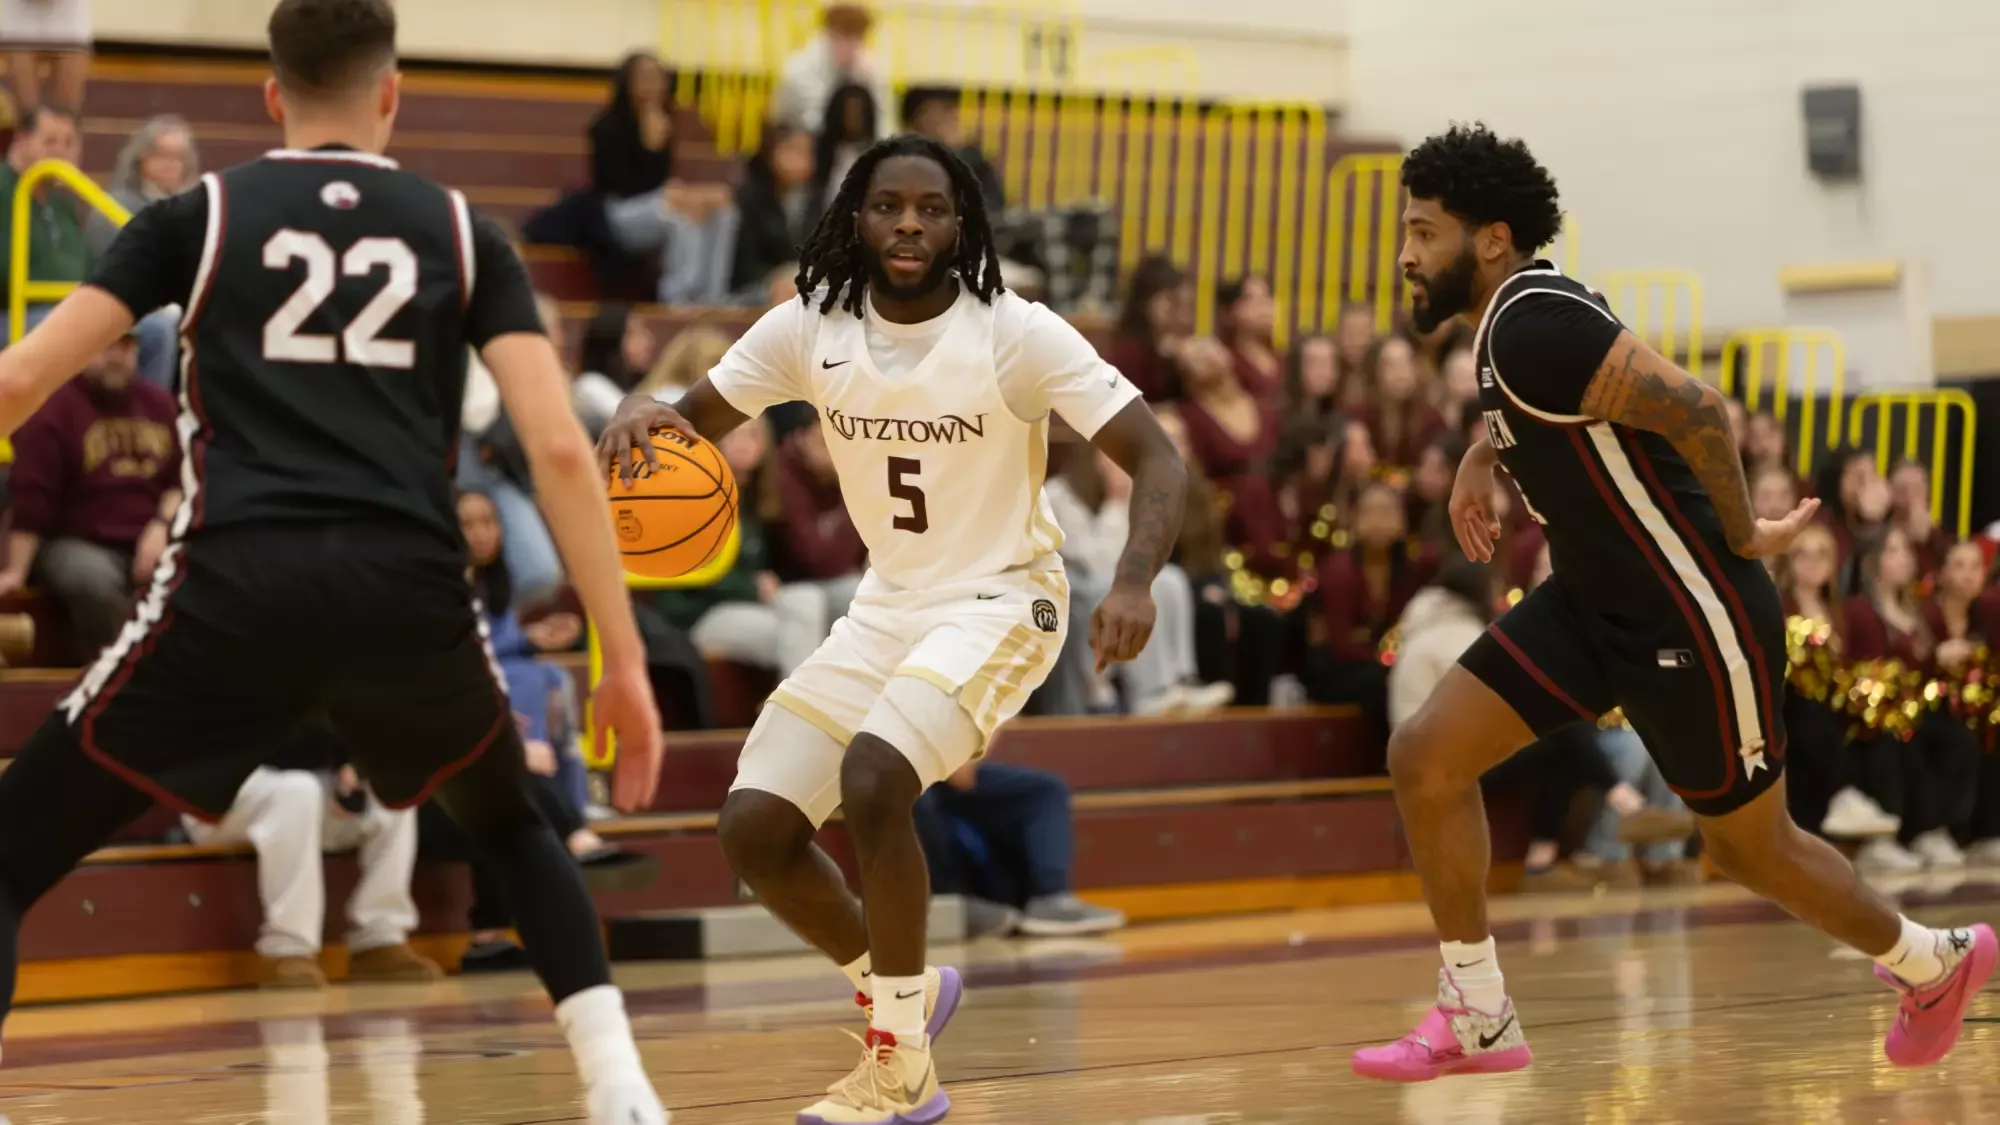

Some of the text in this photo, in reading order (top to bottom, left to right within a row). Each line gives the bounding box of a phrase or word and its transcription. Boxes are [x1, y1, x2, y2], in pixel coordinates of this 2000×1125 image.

[262, 227, 419, 370] 22
[825, 405, 988, 444] KUTZTOWN
[887, 455, 929, 534] 5
